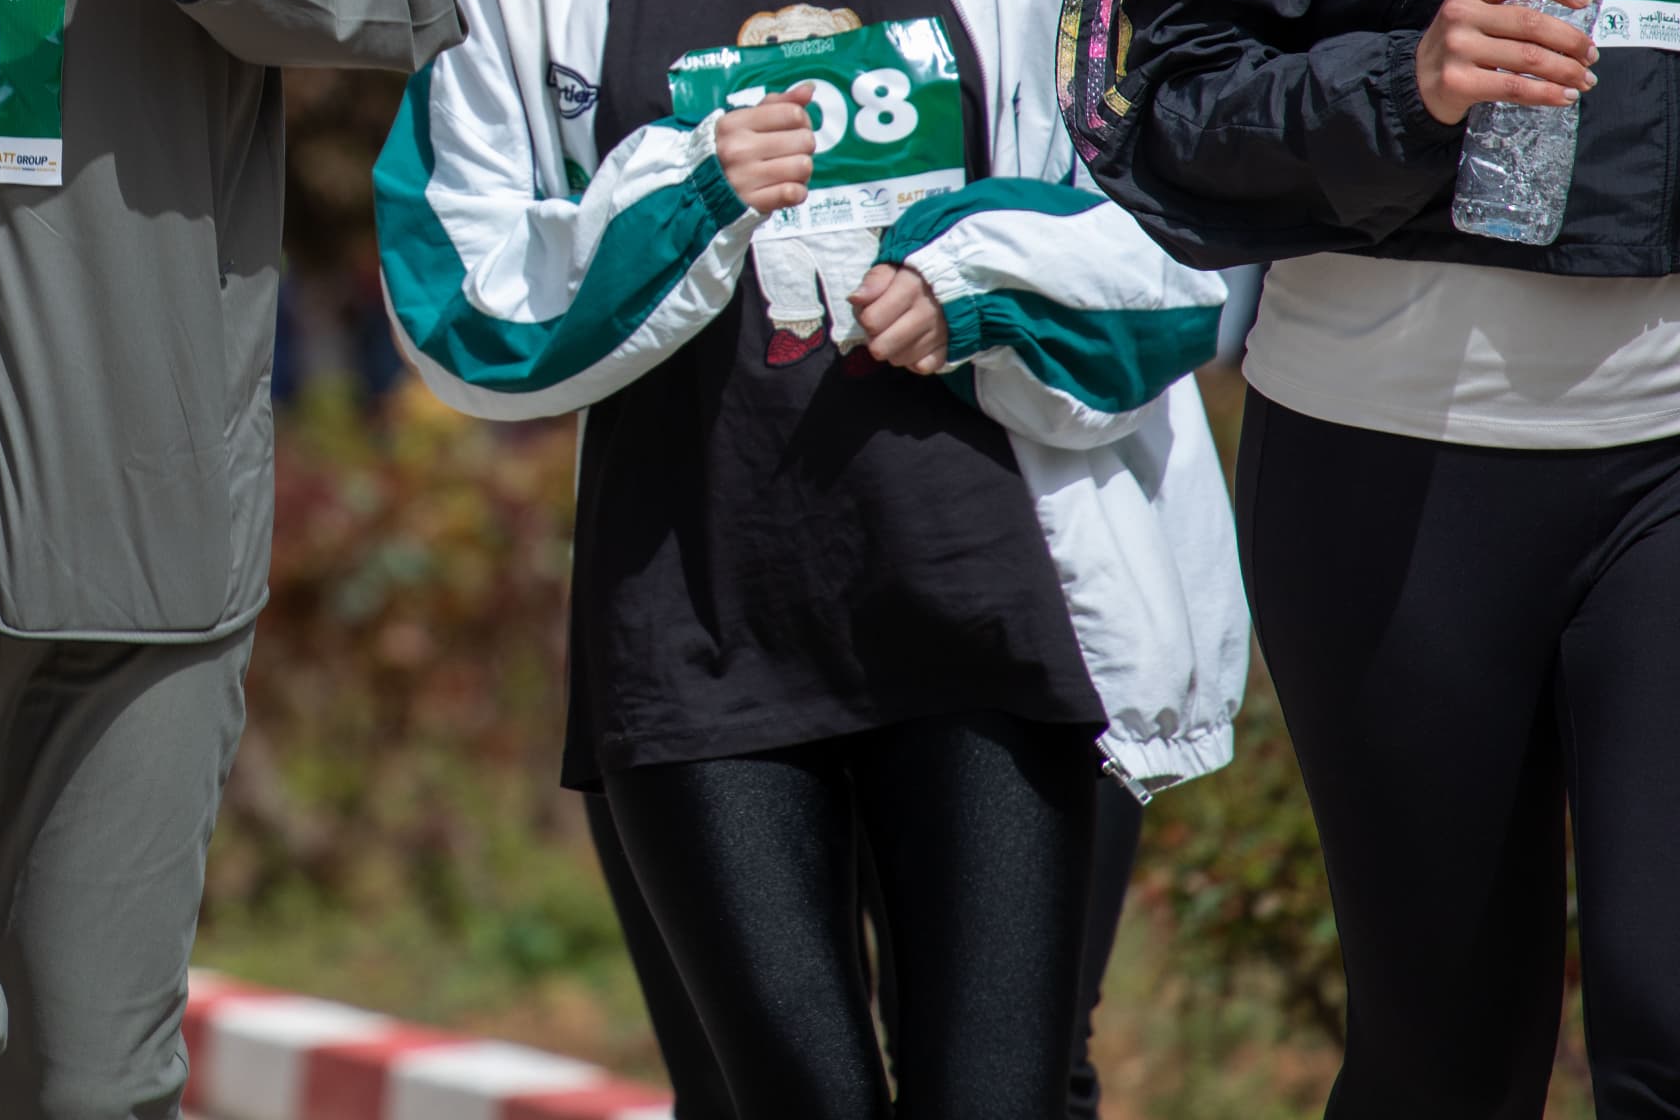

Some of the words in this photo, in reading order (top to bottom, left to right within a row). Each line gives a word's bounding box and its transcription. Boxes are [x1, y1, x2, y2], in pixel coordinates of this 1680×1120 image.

[781, 37, 836, 58] 10KM
[726, 67, 919, 154] 08
[16, 154, 48, 166] GROUP
